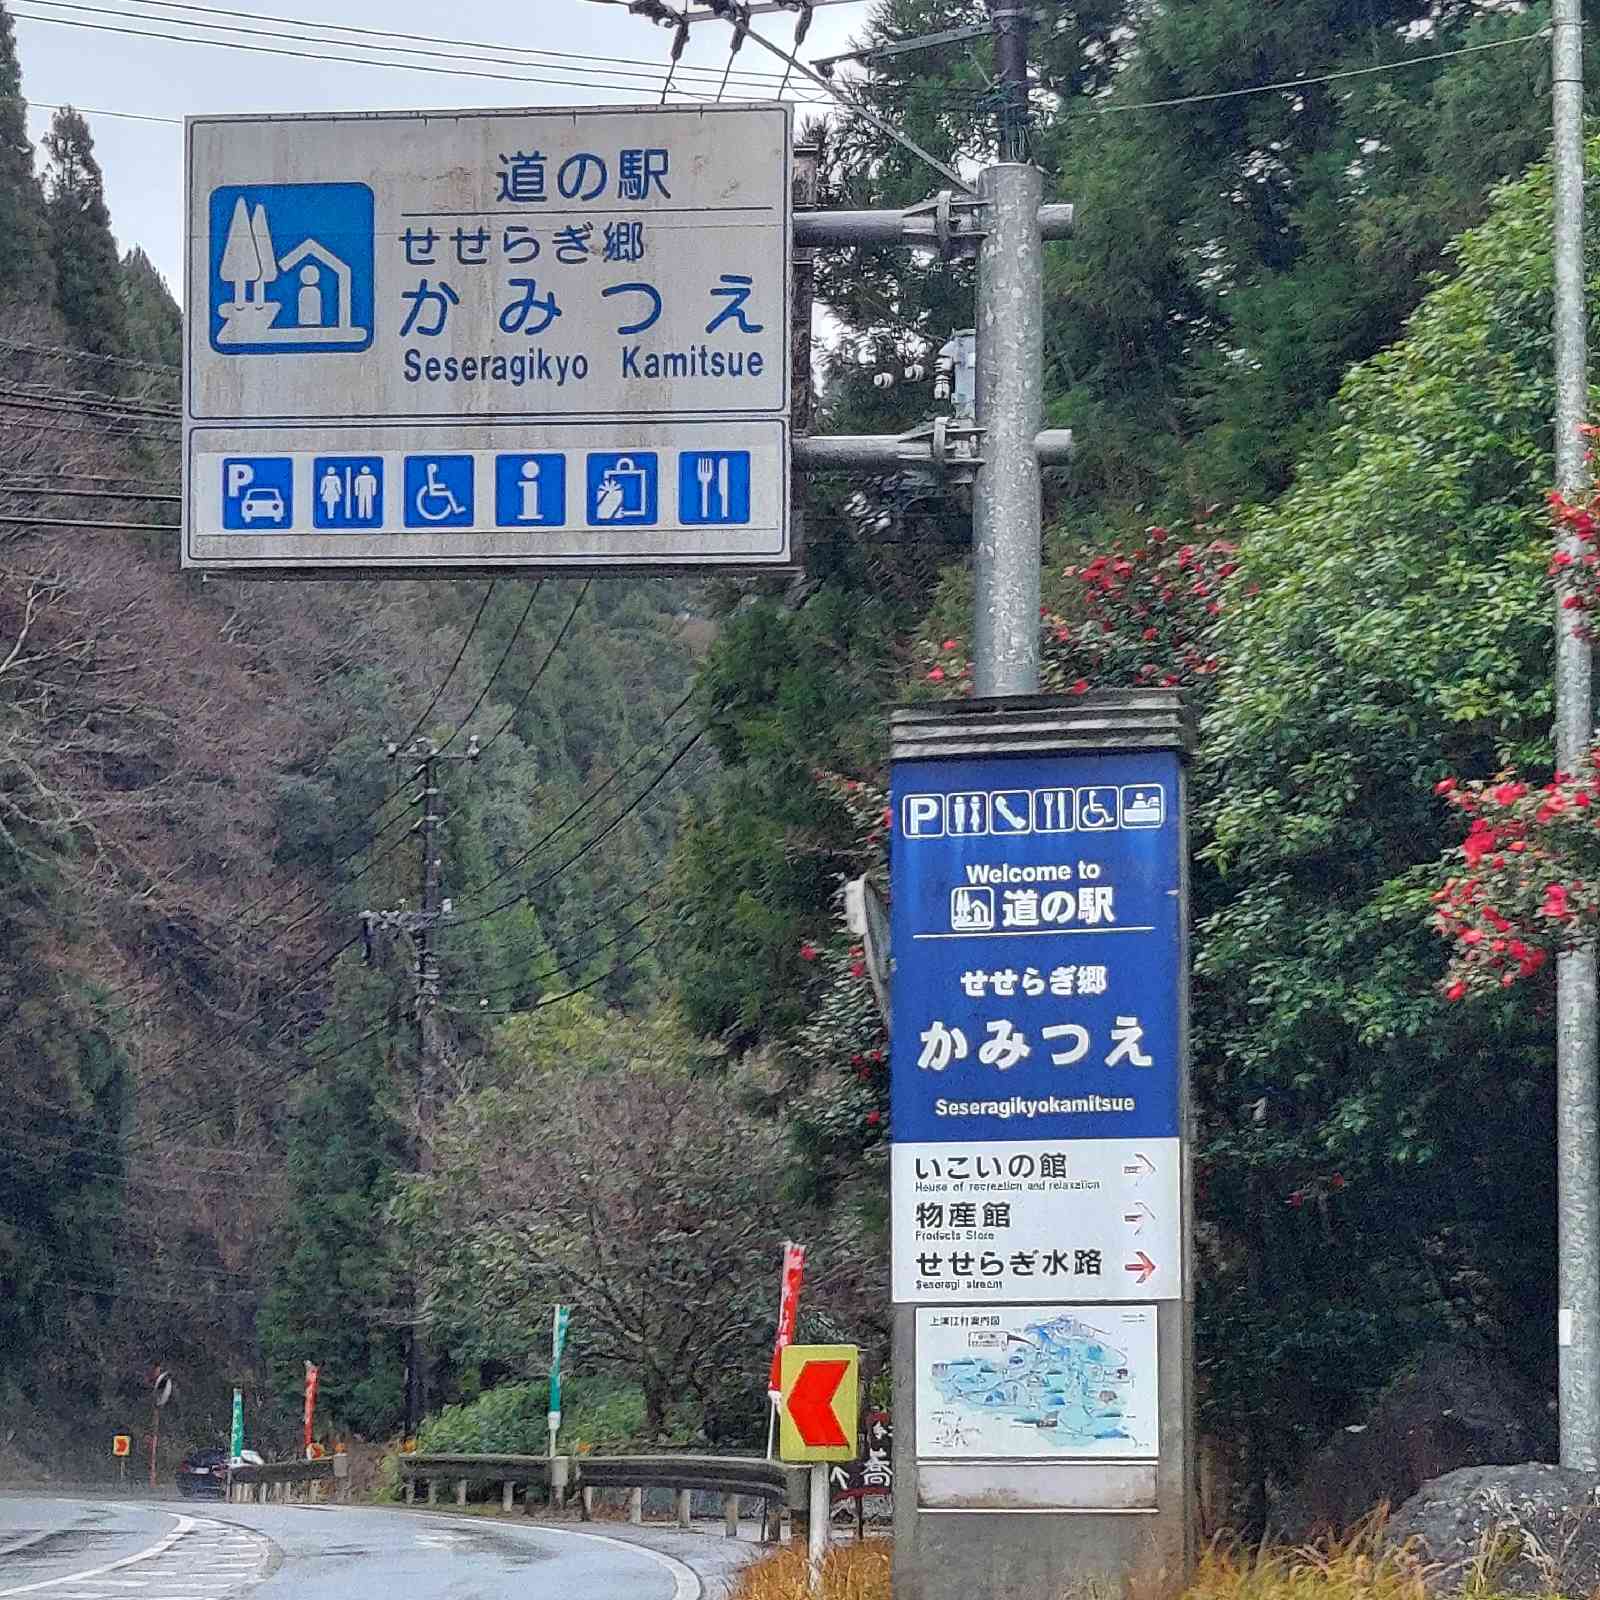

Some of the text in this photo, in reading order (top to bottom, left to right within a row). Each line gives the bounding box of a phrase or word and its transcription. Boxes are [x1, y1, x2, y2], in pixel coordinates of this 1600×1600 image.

[494, 148, 672, 202] 道の駅
[399, 220, 645, 266] せせらぎ郷
[399, 274, 764, 338] かみつえ
[403, 344, 764, 387] Seseragikyo Kamitsue
[965, 860, 1101, 885] Welcome to
[1003, 886, 1114, 927] 道の駅
[960, 964, 1107, 997] せせらぎ郷
[917, 1015, 1153, 1071] かみつえ
[935, 1094, 1136, 1119] Seseragikyokamitsue
[915, 1152, 1067, 1180] いこいの館
[915, 1201, 1011, 1229] 物産館
[915, 1248, 1103, 1277] せせらぎ水路
